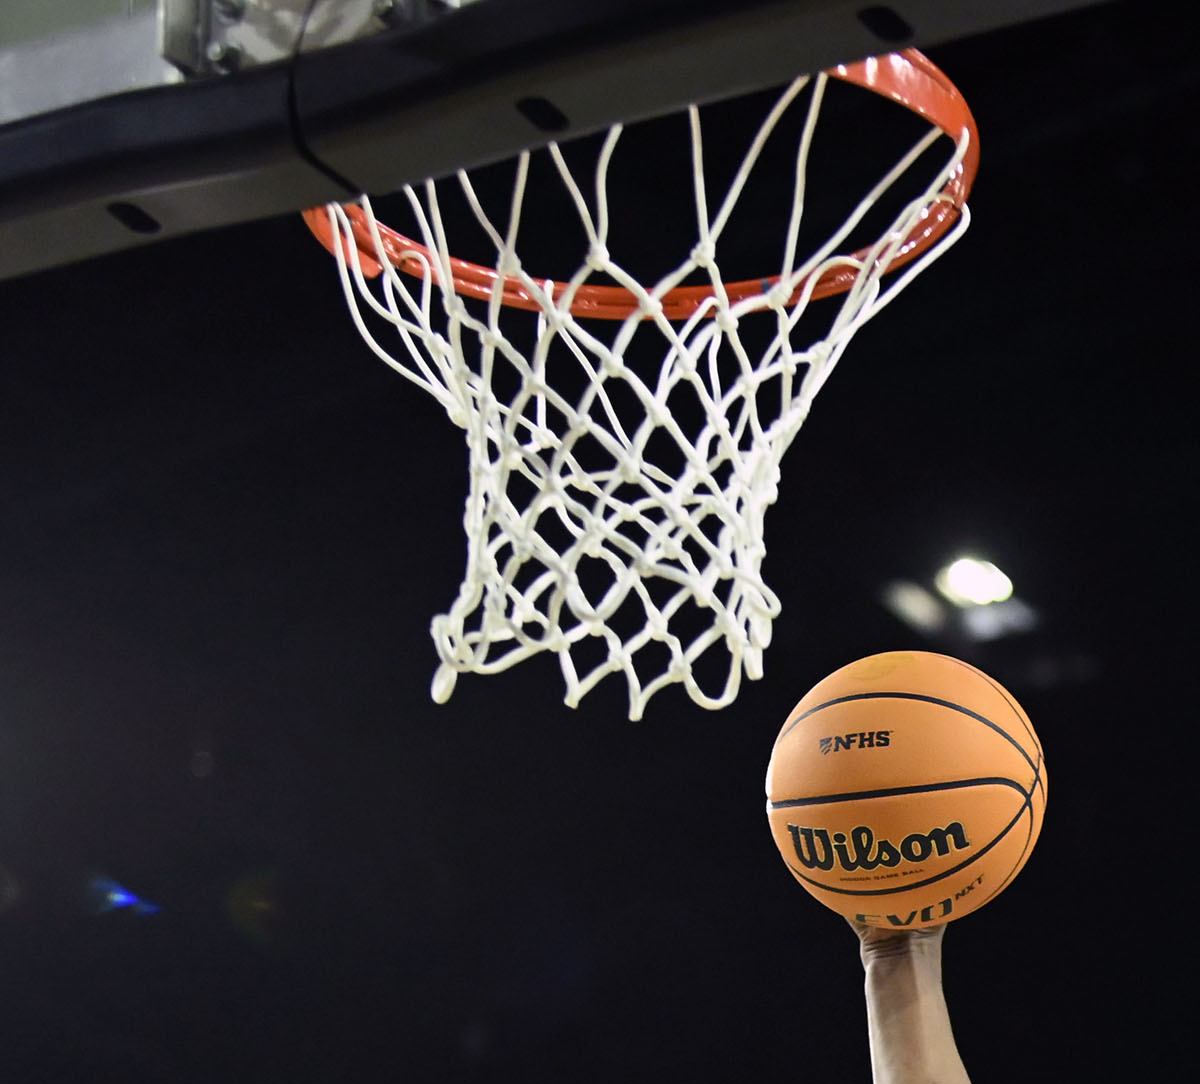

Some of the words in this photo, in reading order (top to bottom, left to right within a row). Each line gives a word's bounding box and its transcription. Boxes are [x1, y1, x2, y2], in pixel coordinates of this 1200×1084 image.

[834, 730, 890, 752] NFHS
[787, 821, 970, 872] Wilson
[955, 873, 984, 900] NXT
